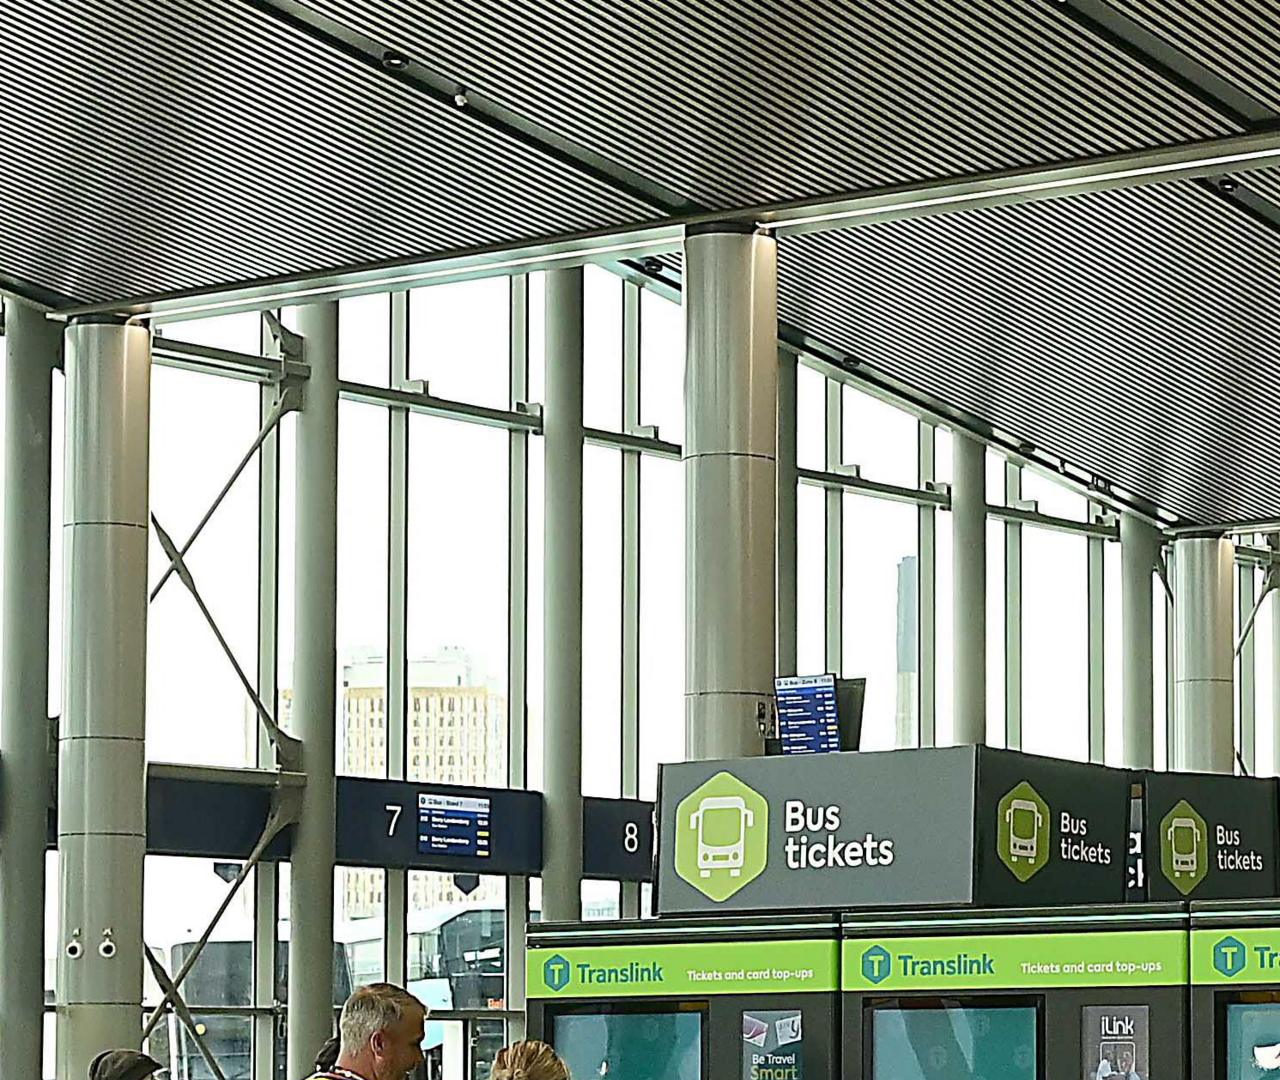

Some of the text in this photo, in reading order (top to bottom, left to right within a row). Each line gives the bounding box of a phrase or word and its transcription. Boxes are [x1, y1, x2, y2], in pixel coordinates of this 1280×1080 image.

[385, 805, 402, 836] 7
[785, 800, 840, 833] Bus
[1060, 812, 1087, 836] Bus
[624, 822, 639, 853] 8
[1216, 825, 1240, 846] Bus
[784, 833, 894, 869] tickets
[1060, 837, 1111, 865] tickets
[1217, 849, 1263, 871] tickets
[576, 961, 664, 984] Translink
[897, 953, 995, 977] Translink
[1020, 960, 1162, 975] Tickets and card top-ups
[1101, 1015, 1134, 1035] iLink
